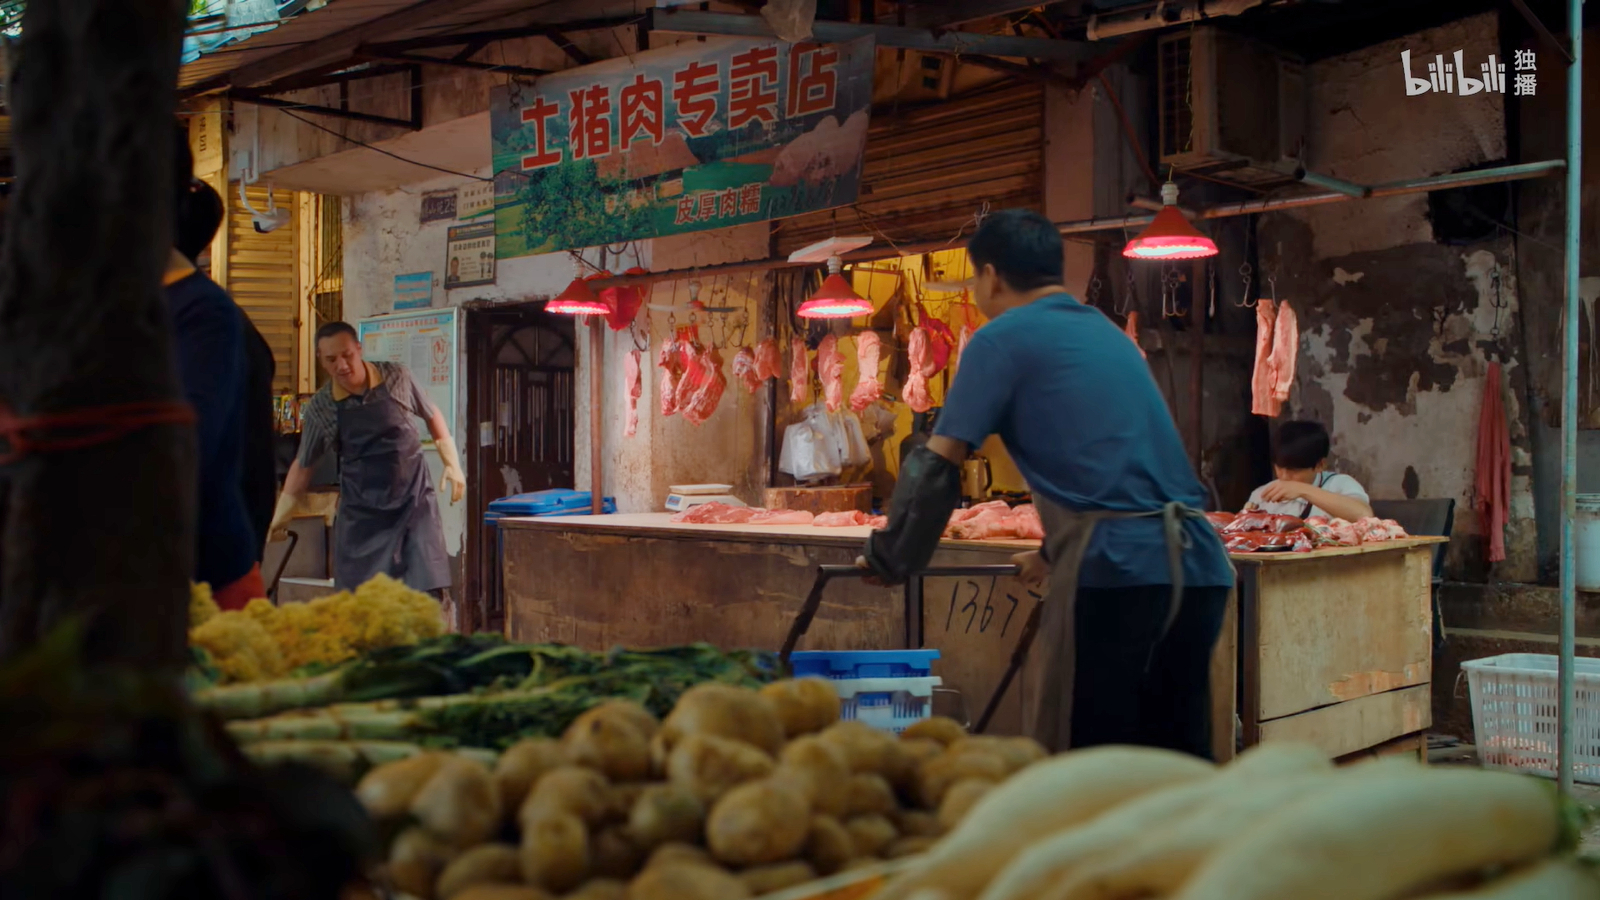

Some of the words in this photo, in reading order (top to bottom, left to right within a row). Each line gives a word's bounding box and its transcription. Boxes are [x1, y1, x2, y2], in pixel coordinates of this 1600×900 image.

[520, 41, 839, 171] 土猪肉专卖店
[674, 182, 762, 225] 皮厚肉糯
